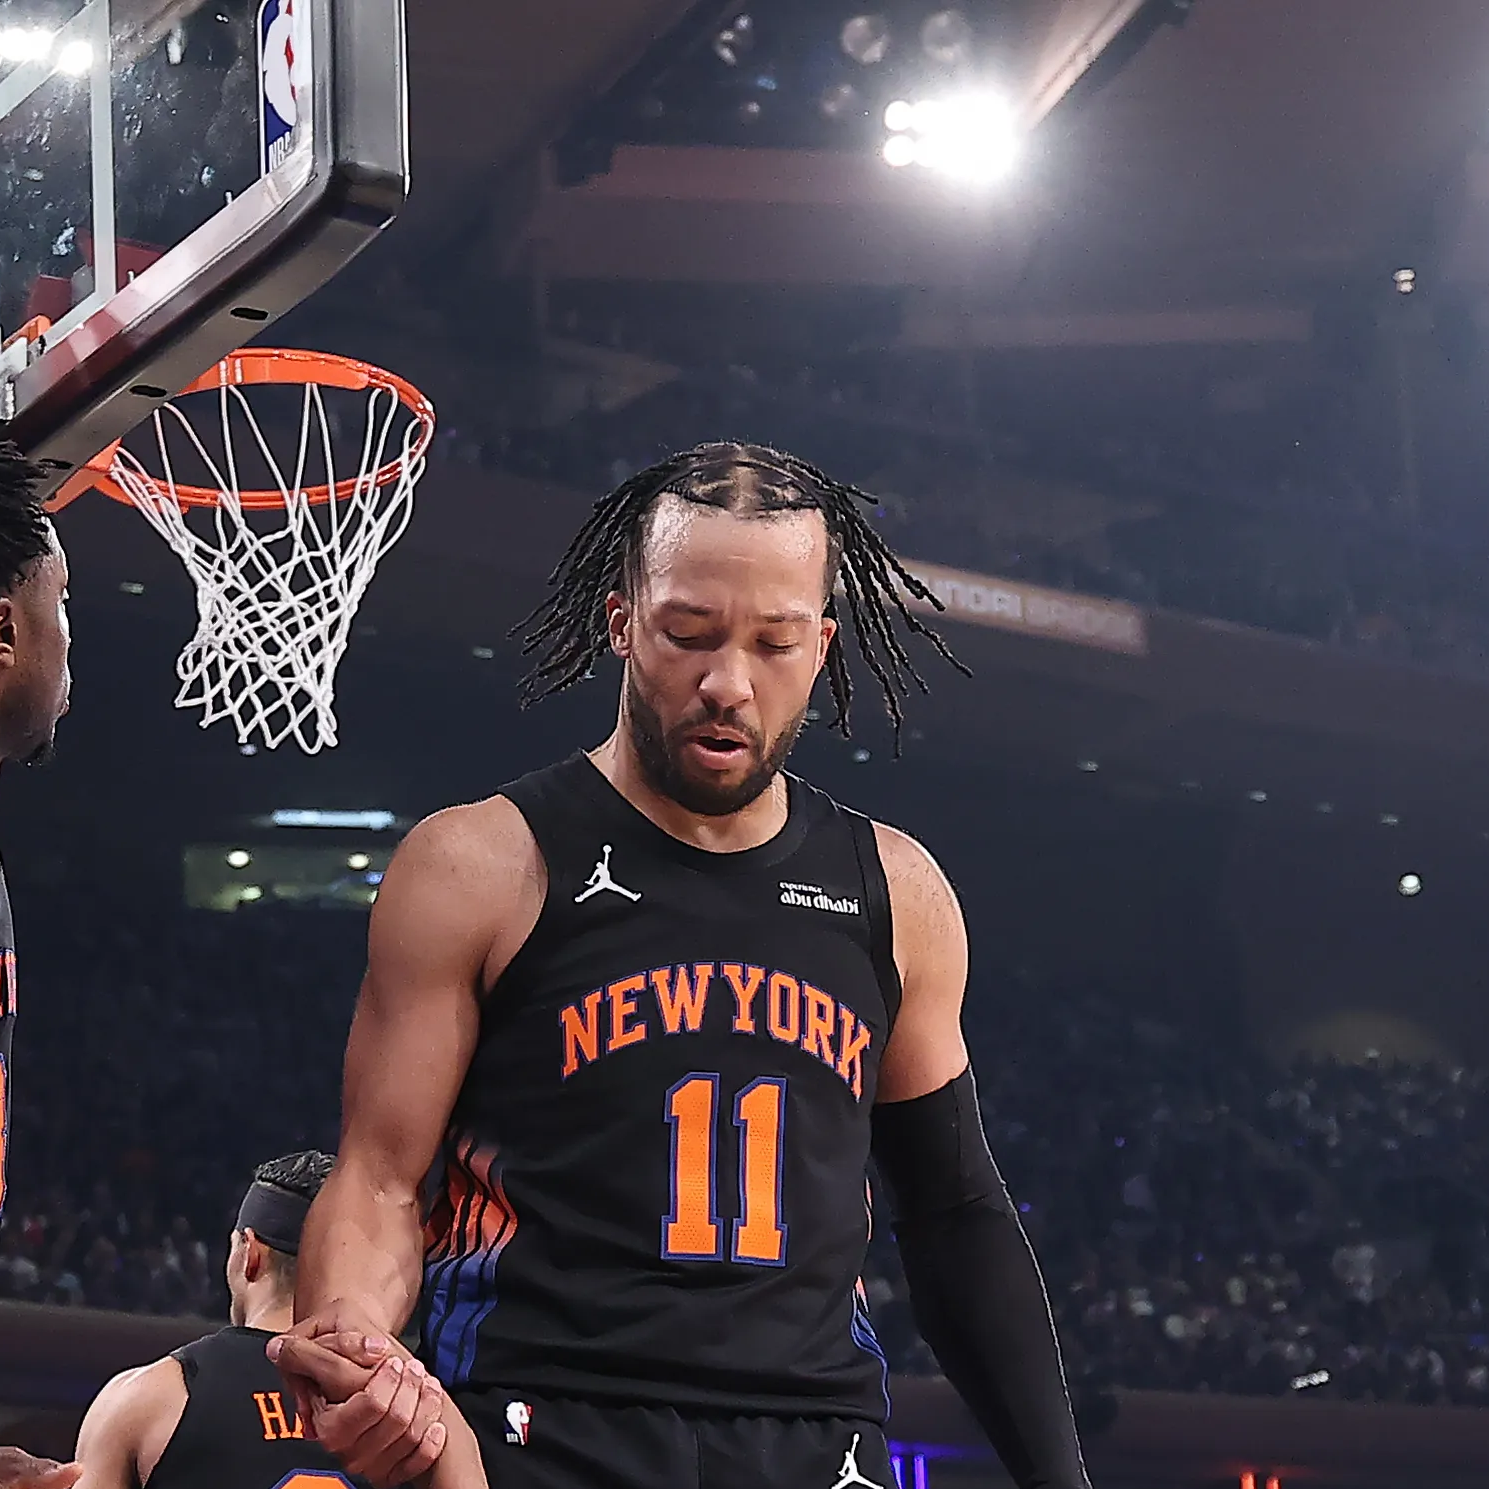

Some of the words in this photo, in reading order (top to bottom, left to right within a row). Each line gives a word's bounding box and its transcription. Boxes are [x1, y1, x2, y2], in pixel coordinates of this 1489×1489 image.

[780, 890, 812, 908] abu
[813, 894, 860, 915] dhabi
[558, 962, 715, 1080] NEW
[719, 961, 872, 1103] YORK
[660, 1071, 788, 1267] 11
